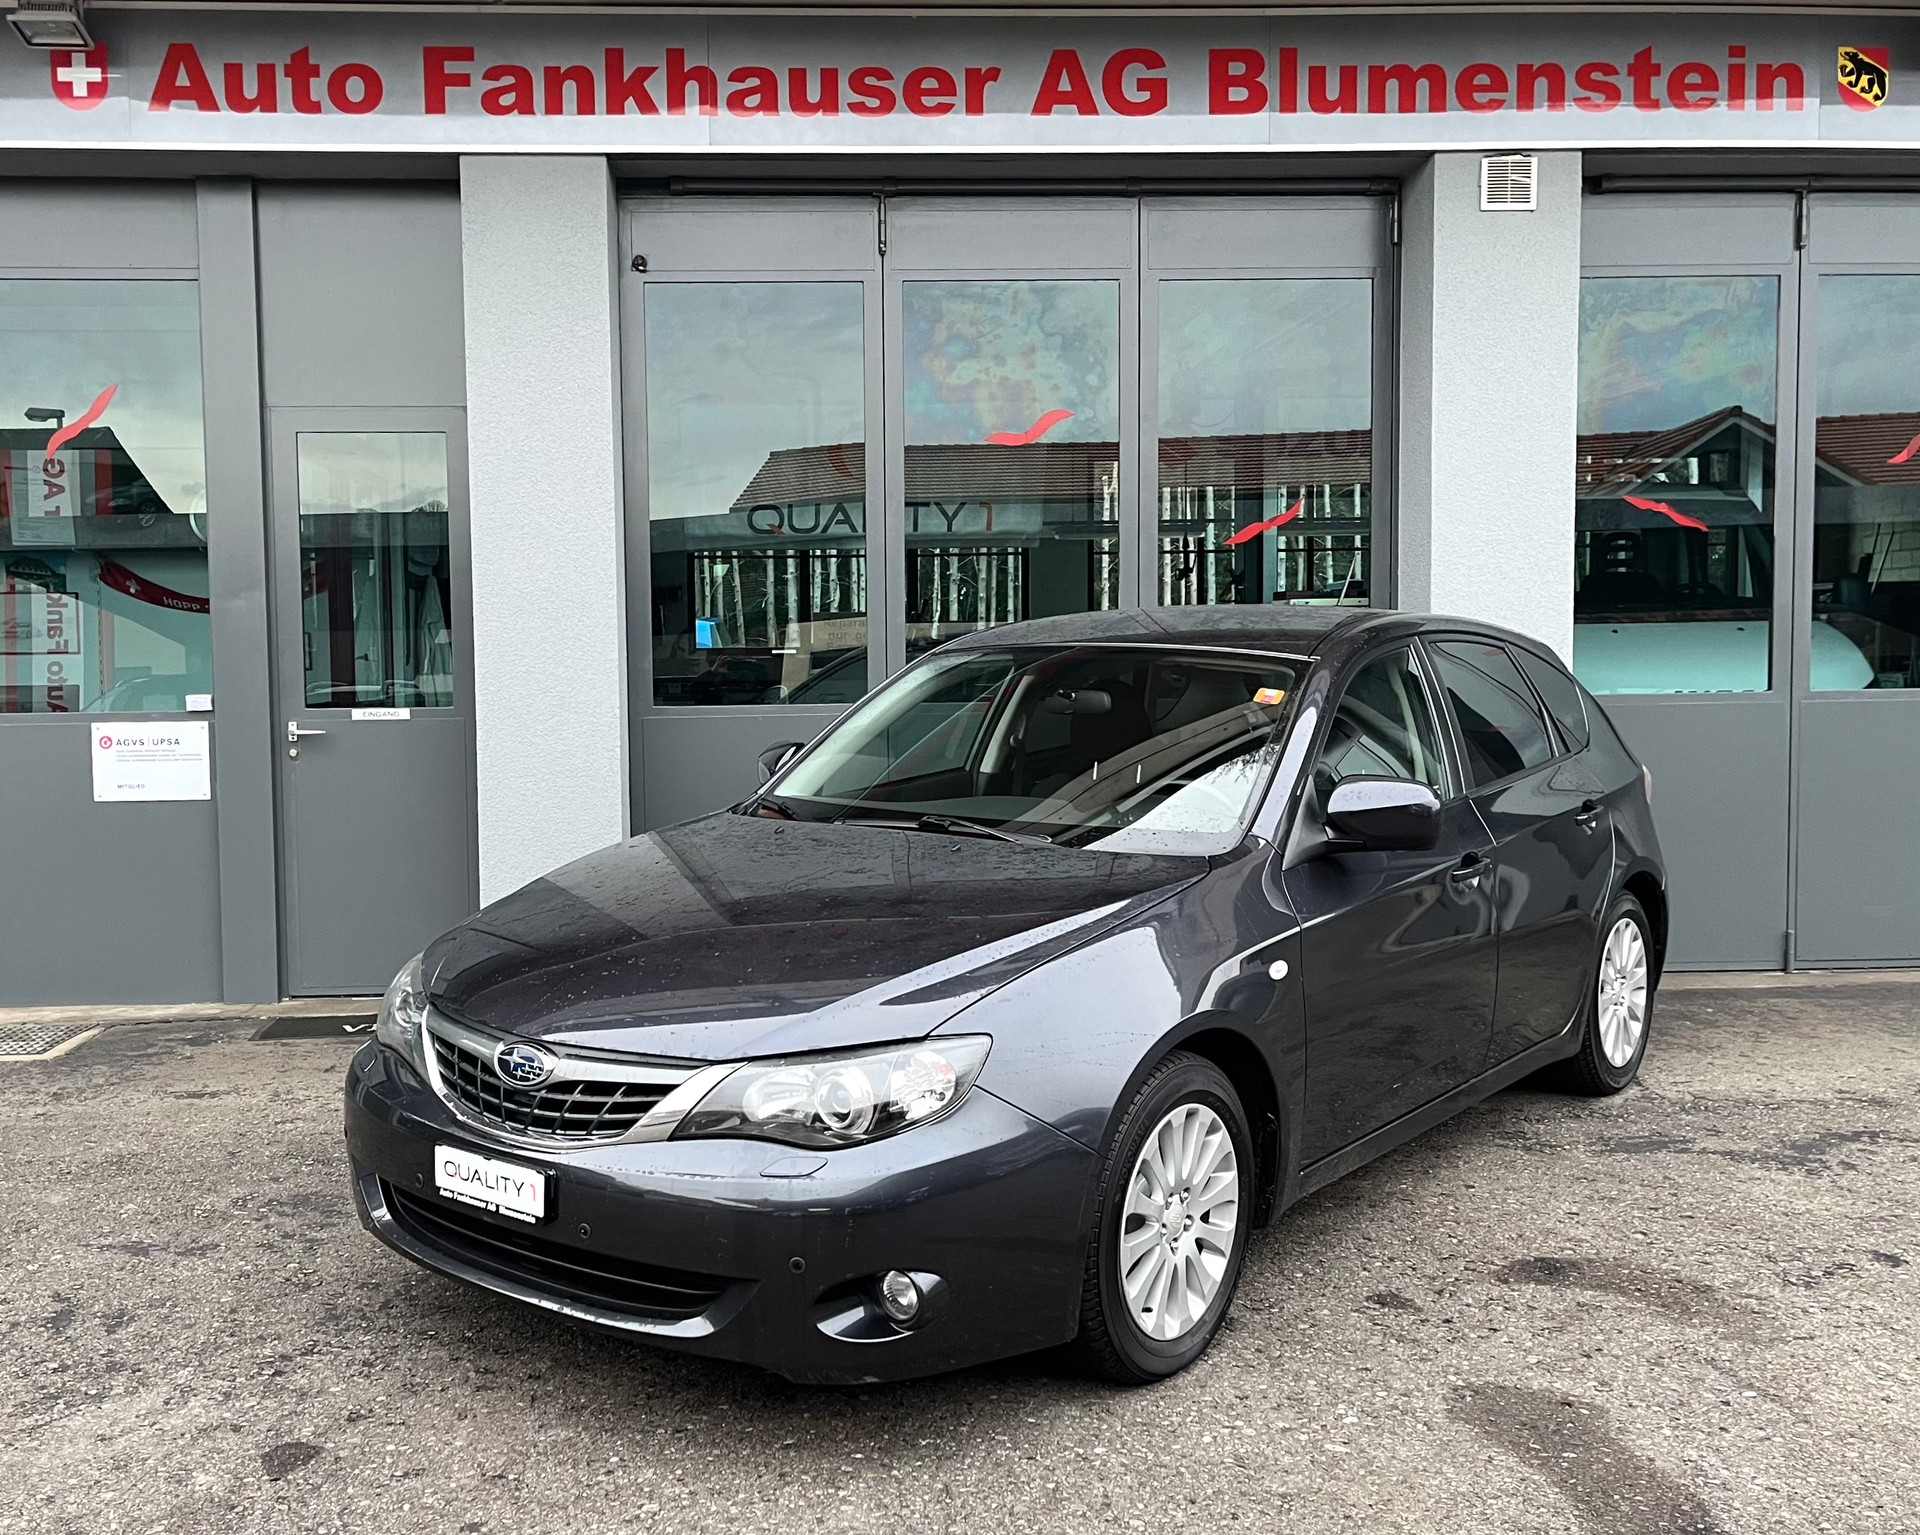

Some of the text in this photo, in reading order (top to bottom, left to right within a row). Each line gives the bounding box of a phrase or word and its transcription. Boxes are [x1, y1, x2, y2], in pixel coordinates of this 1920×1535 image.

[149, 43, 1806, 117] Auto Fankhauser AG Blumenstein
[746, 501, 968, 536] QUATY
[162, 596, 200, 610] HOPP
[823, 619, 868, 630] Repara
[362, 710, 400, 718] EINGANG
[115, 738, 181, 747] AGVS UPSA
[444, 1160, 536, 1202] QUALITY 1
